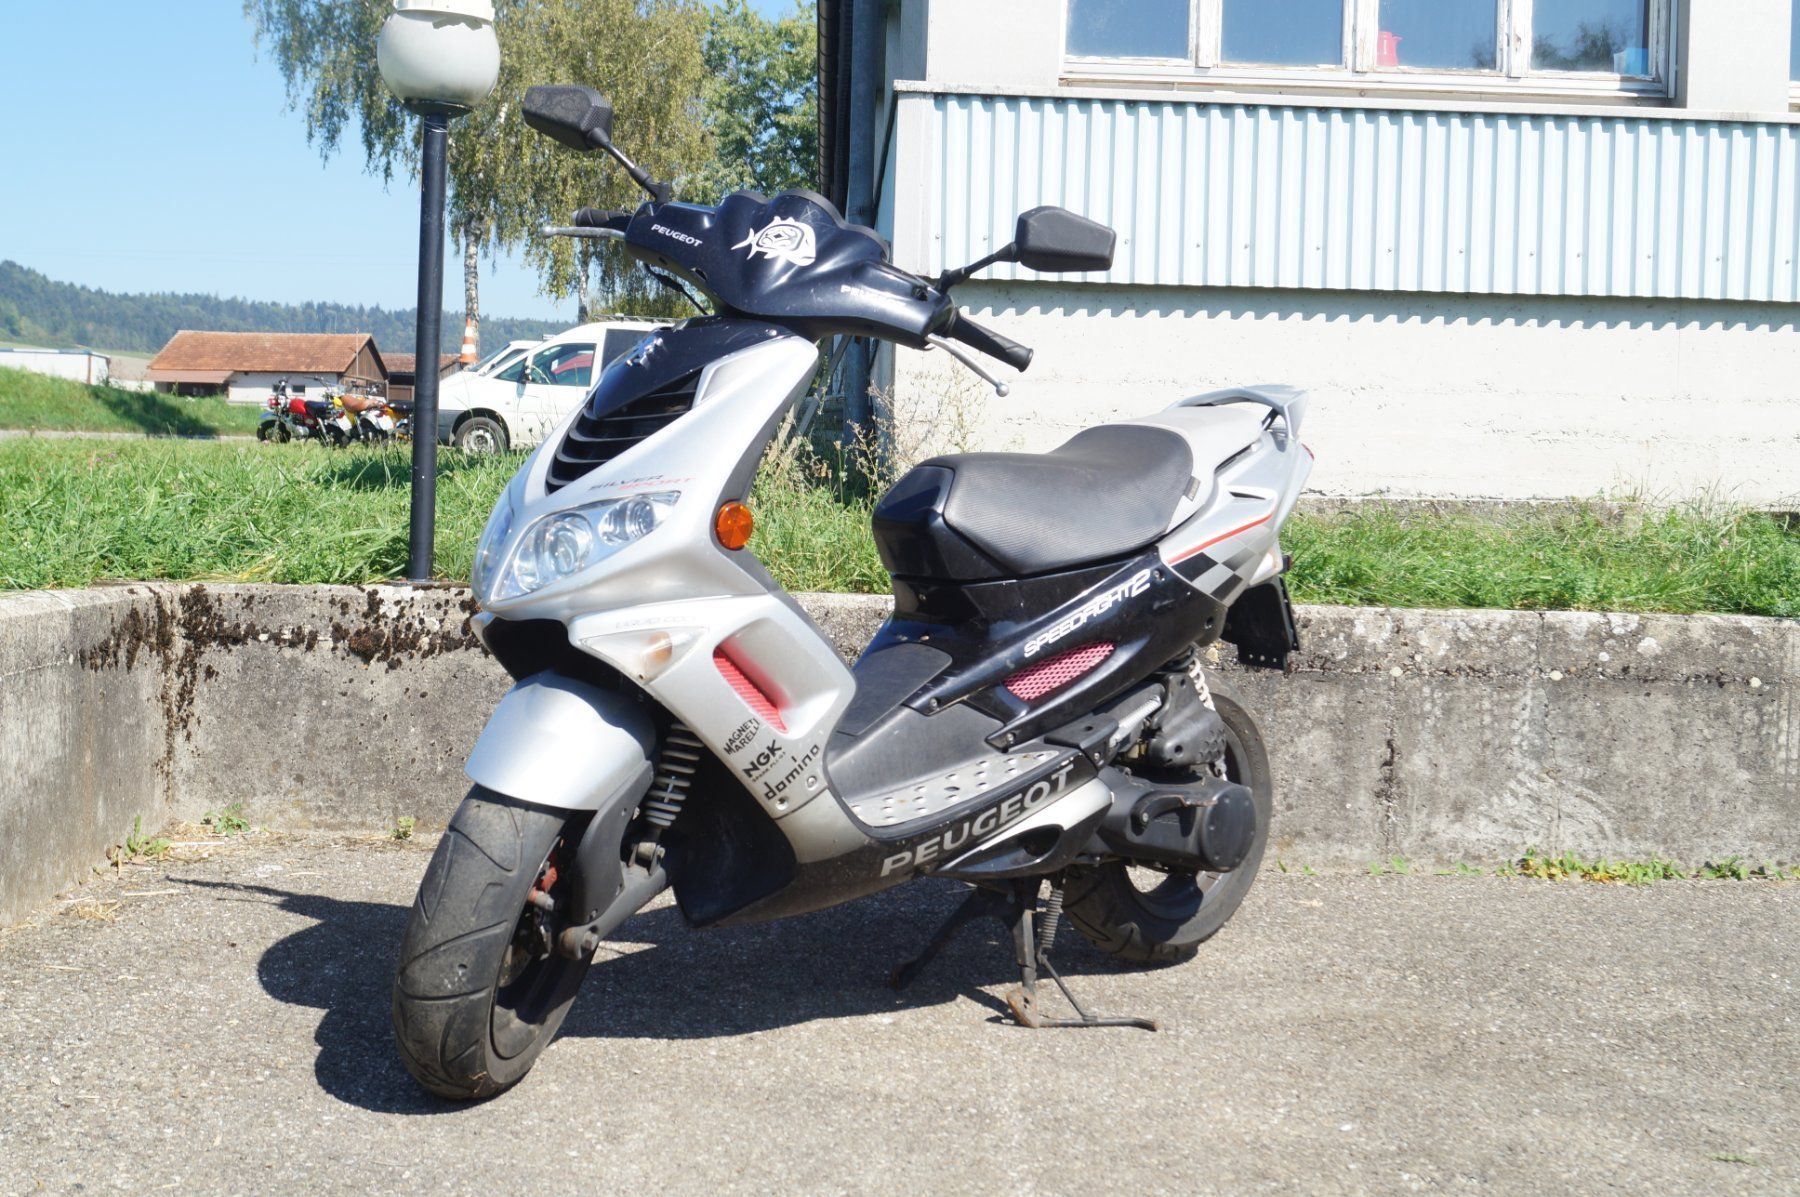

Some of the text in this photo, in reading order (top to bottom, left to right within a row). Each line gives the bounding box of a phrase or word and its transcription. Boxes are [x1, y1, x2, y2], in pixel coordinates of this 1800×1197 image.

[651, 224, 703, 247] PEUGEOT
[742, 739, 782, 778] NGK
[764, 744, 820, 800] domino
[880, 764, 1074, 877] PEUGEOT
